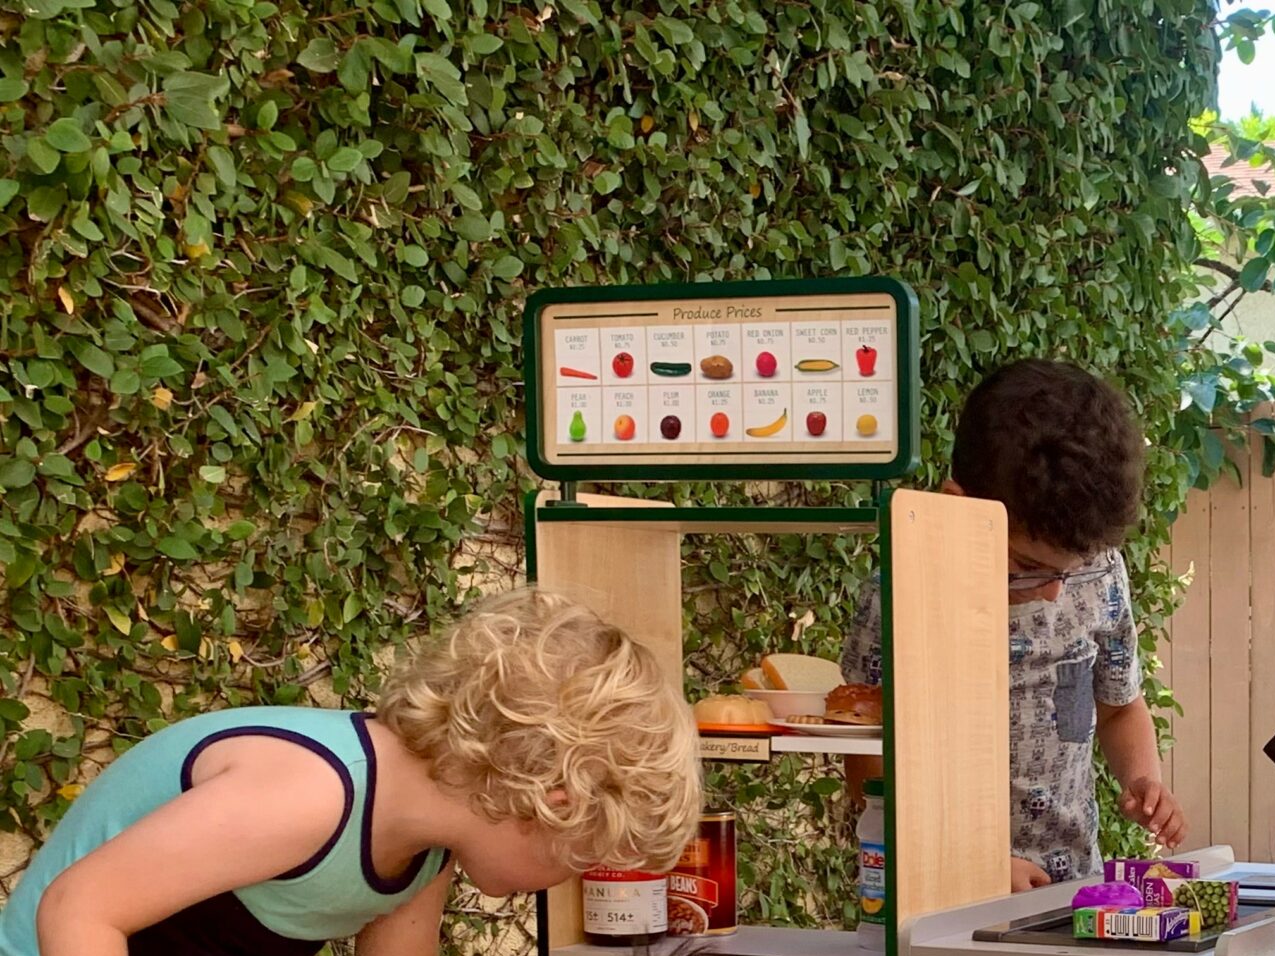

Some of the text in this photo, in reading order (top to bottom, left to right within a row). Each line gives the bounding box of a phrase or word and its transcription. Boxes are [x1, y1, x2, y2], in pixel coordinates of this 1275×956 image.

[673, 305, 762, 320] Produce Prices
[706, 330, 730, 338] POTATO
[763, 329, 784, 337] ONION
[795, 328, 816, 336] SWEET
[846, 327, 888, 335] RED PEPPER
[565, 335, 588, 343] CARROT
[653, 332, 684, 340] CUCUMBER
[614, 392, 634, 400] PEACH
[663, 391, 679, 399] PLUM
[708, 390, 731, 398] ORANGE
[754, 389, 779, 397] BANANA
[807, 388, 828, 396] APPLE
[857, 388, 879, 396] LEMON
[571, 393, 587, 401] PEAR
[700, 741, 759, 754] akery/Bread
[863, 852, 884, 866] Dole
[671, 876, 698, 894] BEANS
